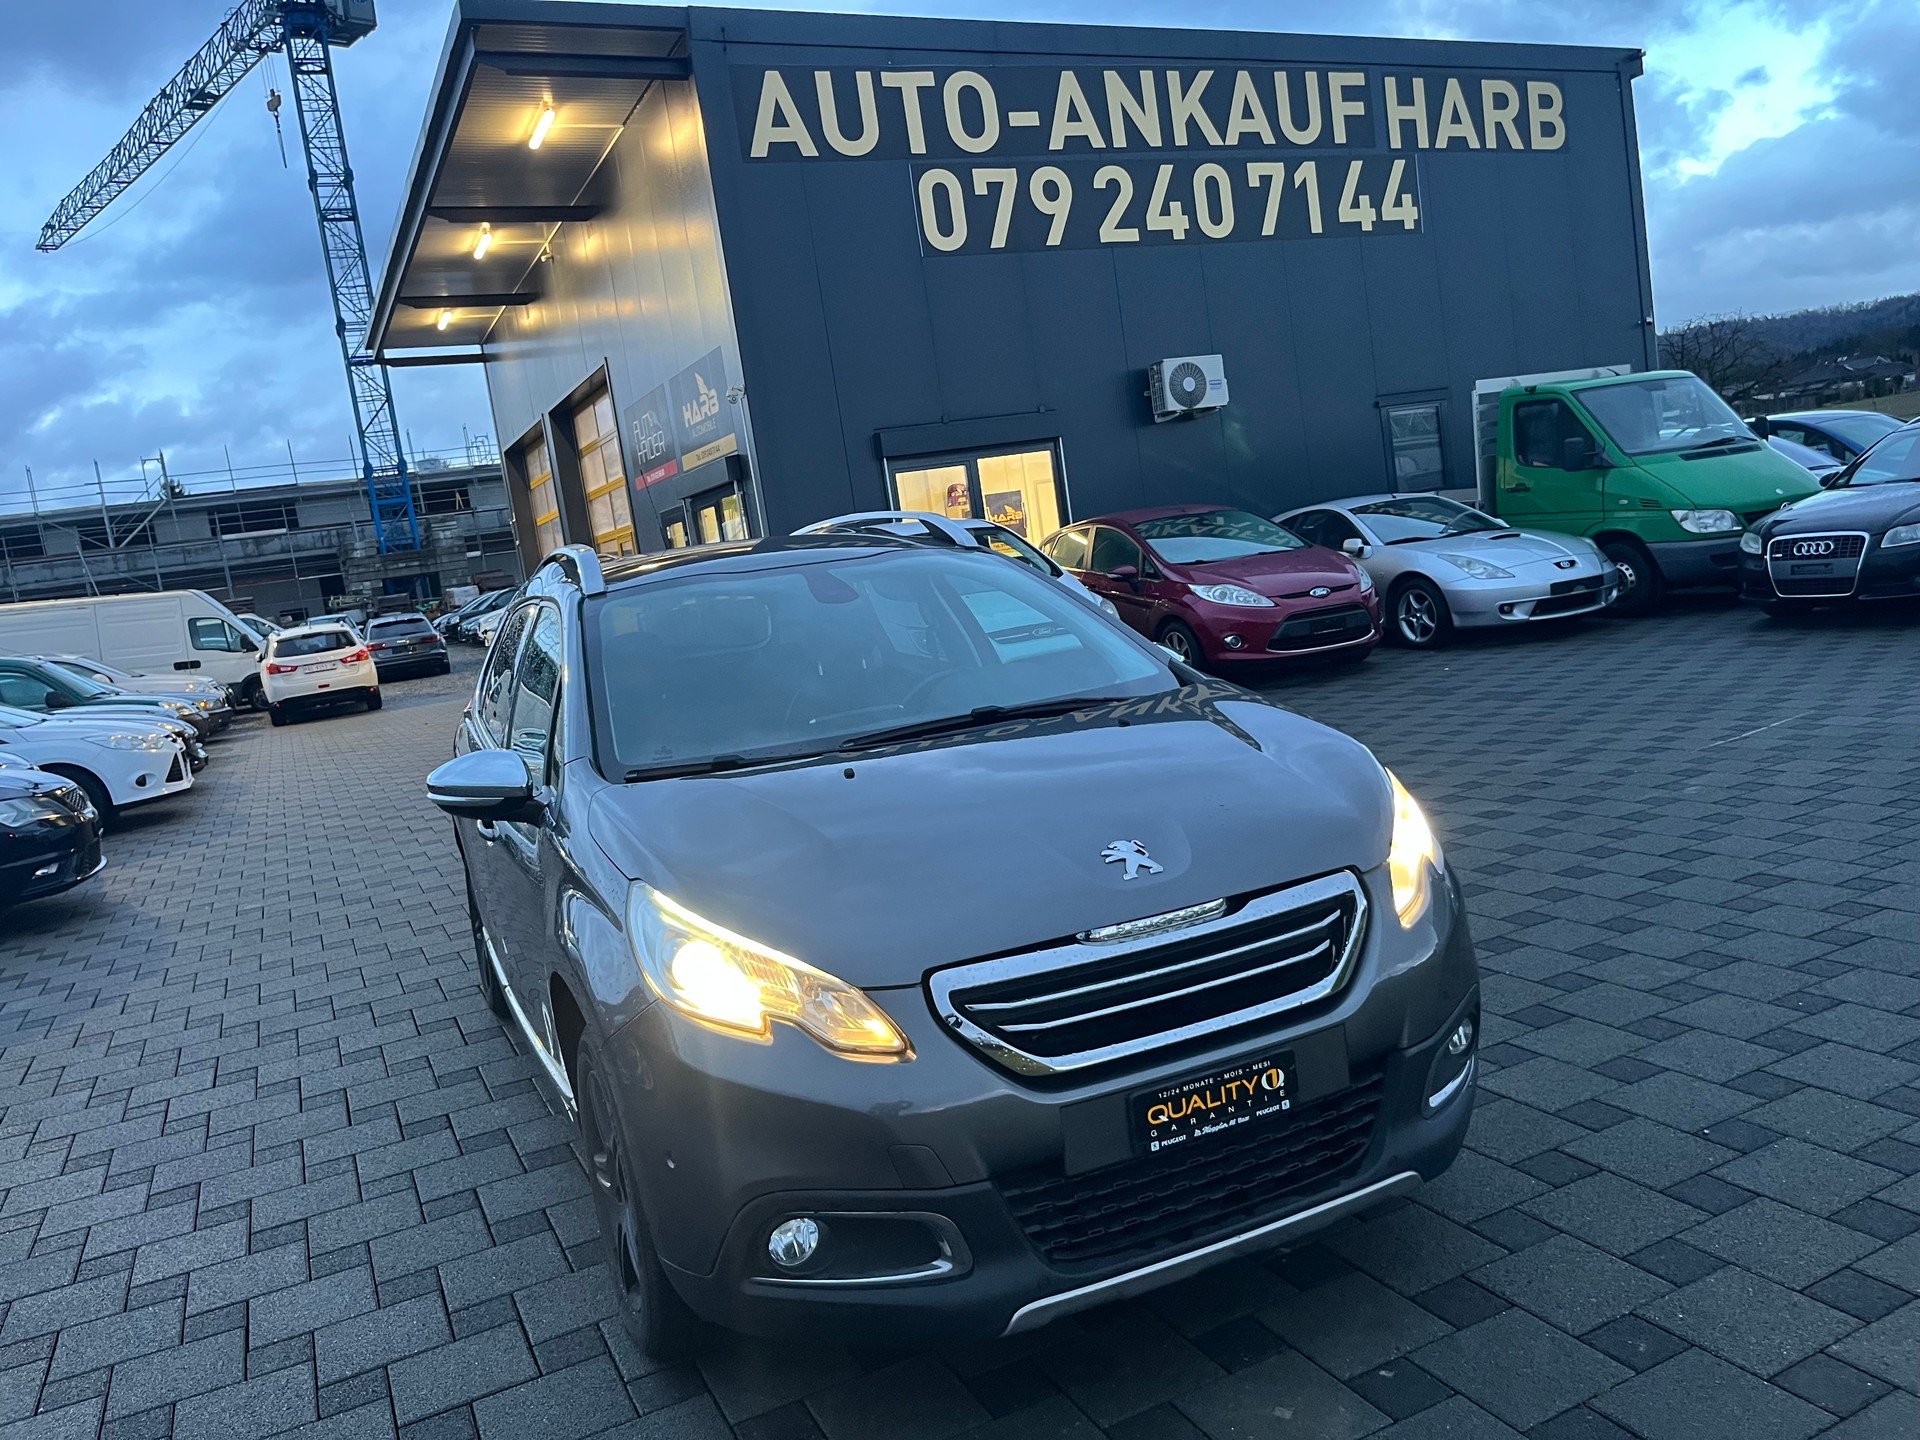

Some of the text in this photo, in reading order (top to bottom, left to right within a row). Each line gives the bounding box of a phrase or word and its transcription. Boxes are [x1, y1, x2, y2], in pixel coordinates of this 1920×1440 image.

[750, 70, 1566, 158] AUTO-ANKAUF HARB
[918, 159, 1418, 252] 079 240 71 44
[682, 389, 719, 428] HARB
[1147, 1075, 1259, 1125] QUALITY
[1158, 1087, 1180, 1099] 12/24
[1183, 1077, 1214, 1092] MONATE
[1223, 1068, 1243, 1080] MOIS
[1252, 1060, 1271, 1071] MESI
[1161, 1134, 1187, 1147] PEUGEOT
